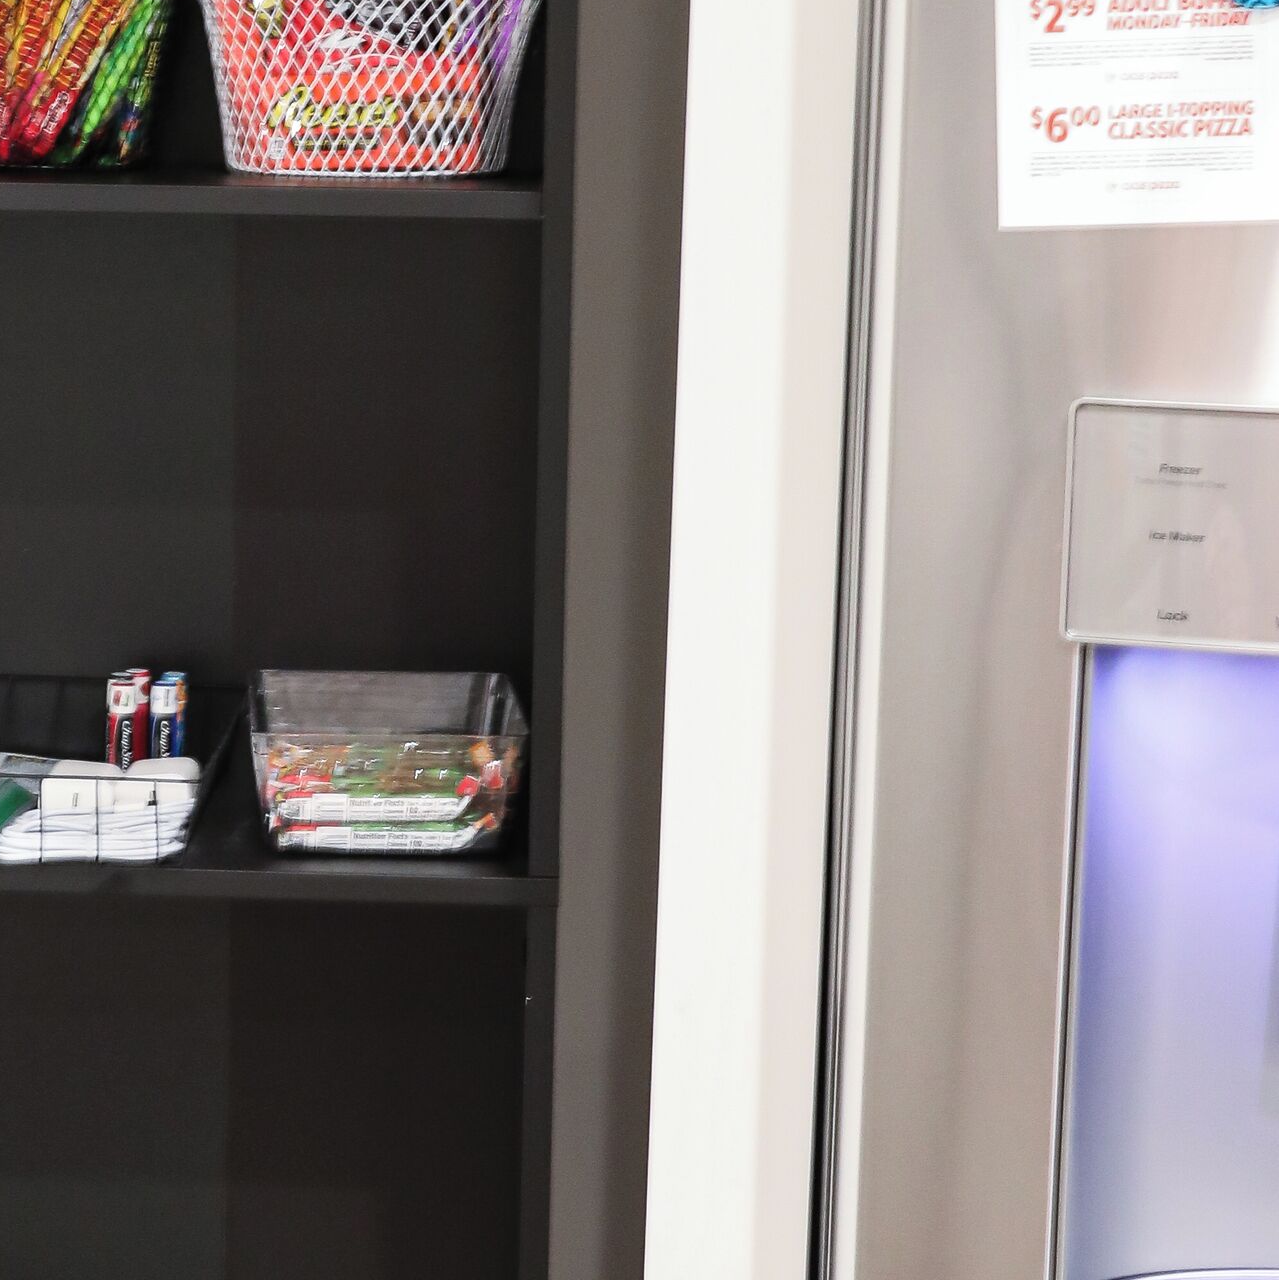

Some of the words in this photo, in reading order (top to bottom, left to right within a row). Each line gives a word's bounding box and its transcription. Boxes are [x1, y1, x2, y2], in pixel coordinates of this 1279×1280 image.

[1107, 103, 1163, 120] LARGE
[1107, 120, 1189, 141] CLASSIC
[1194, 117, 1254, 138] PIZZA
